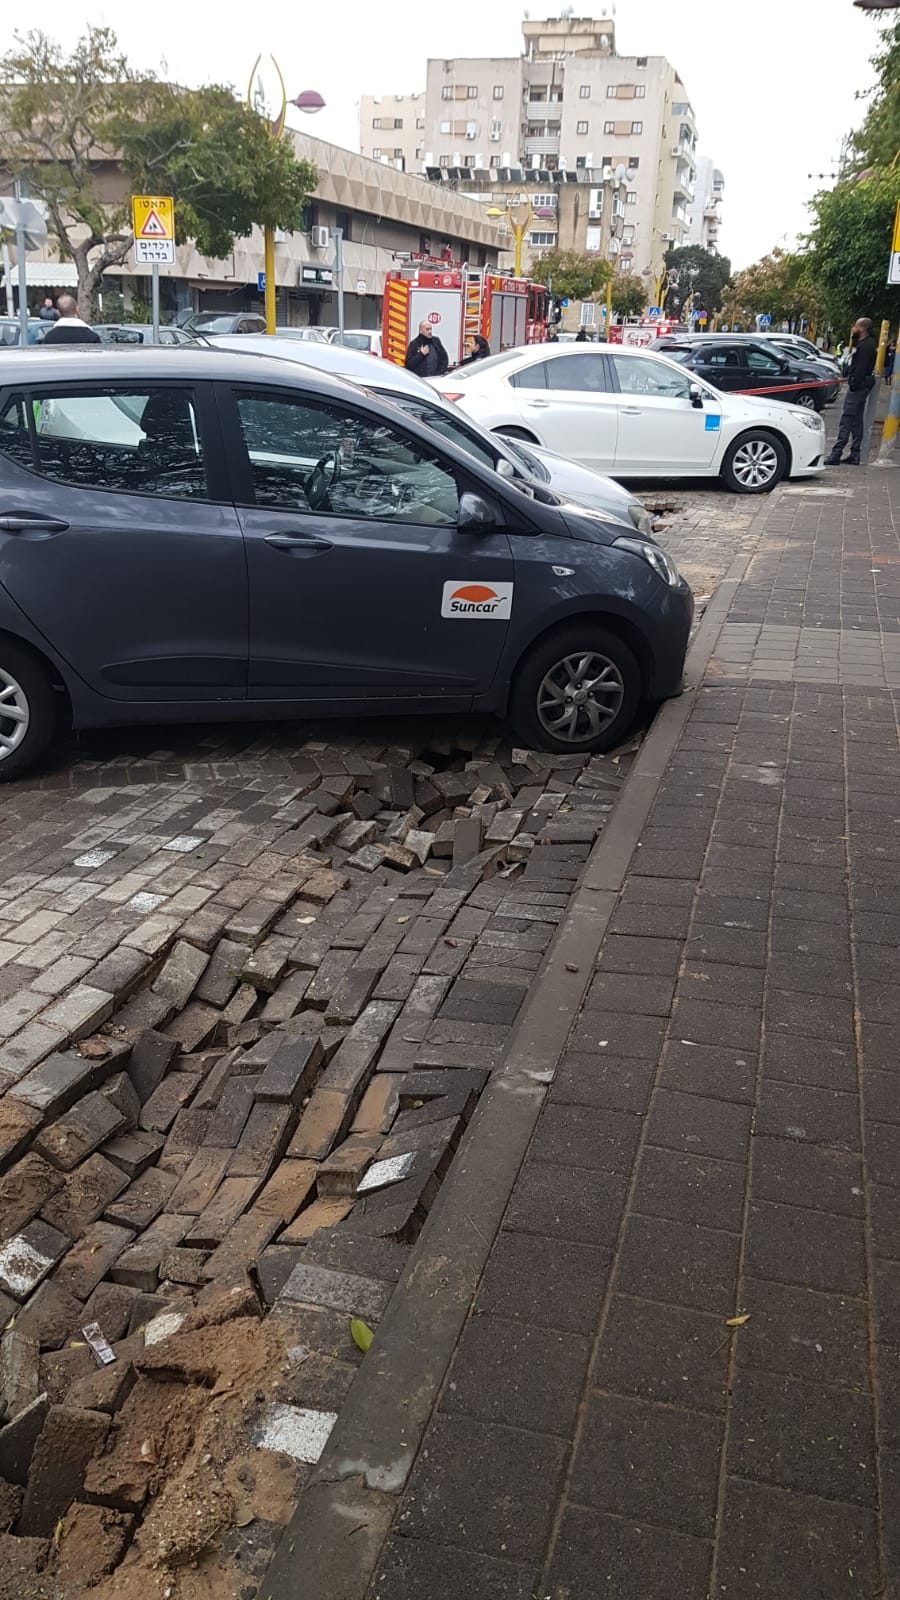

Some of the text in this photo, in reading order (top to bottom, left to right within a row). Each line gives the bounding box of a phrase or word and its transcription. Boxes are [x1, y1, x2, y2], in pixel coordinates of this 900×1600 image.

[140, 242, 169, 250] ילדים
[142, 252, 168, 261] בדרך
[428, 313, 440, 322] 401
[450, 601, 498, 613] Suncar
